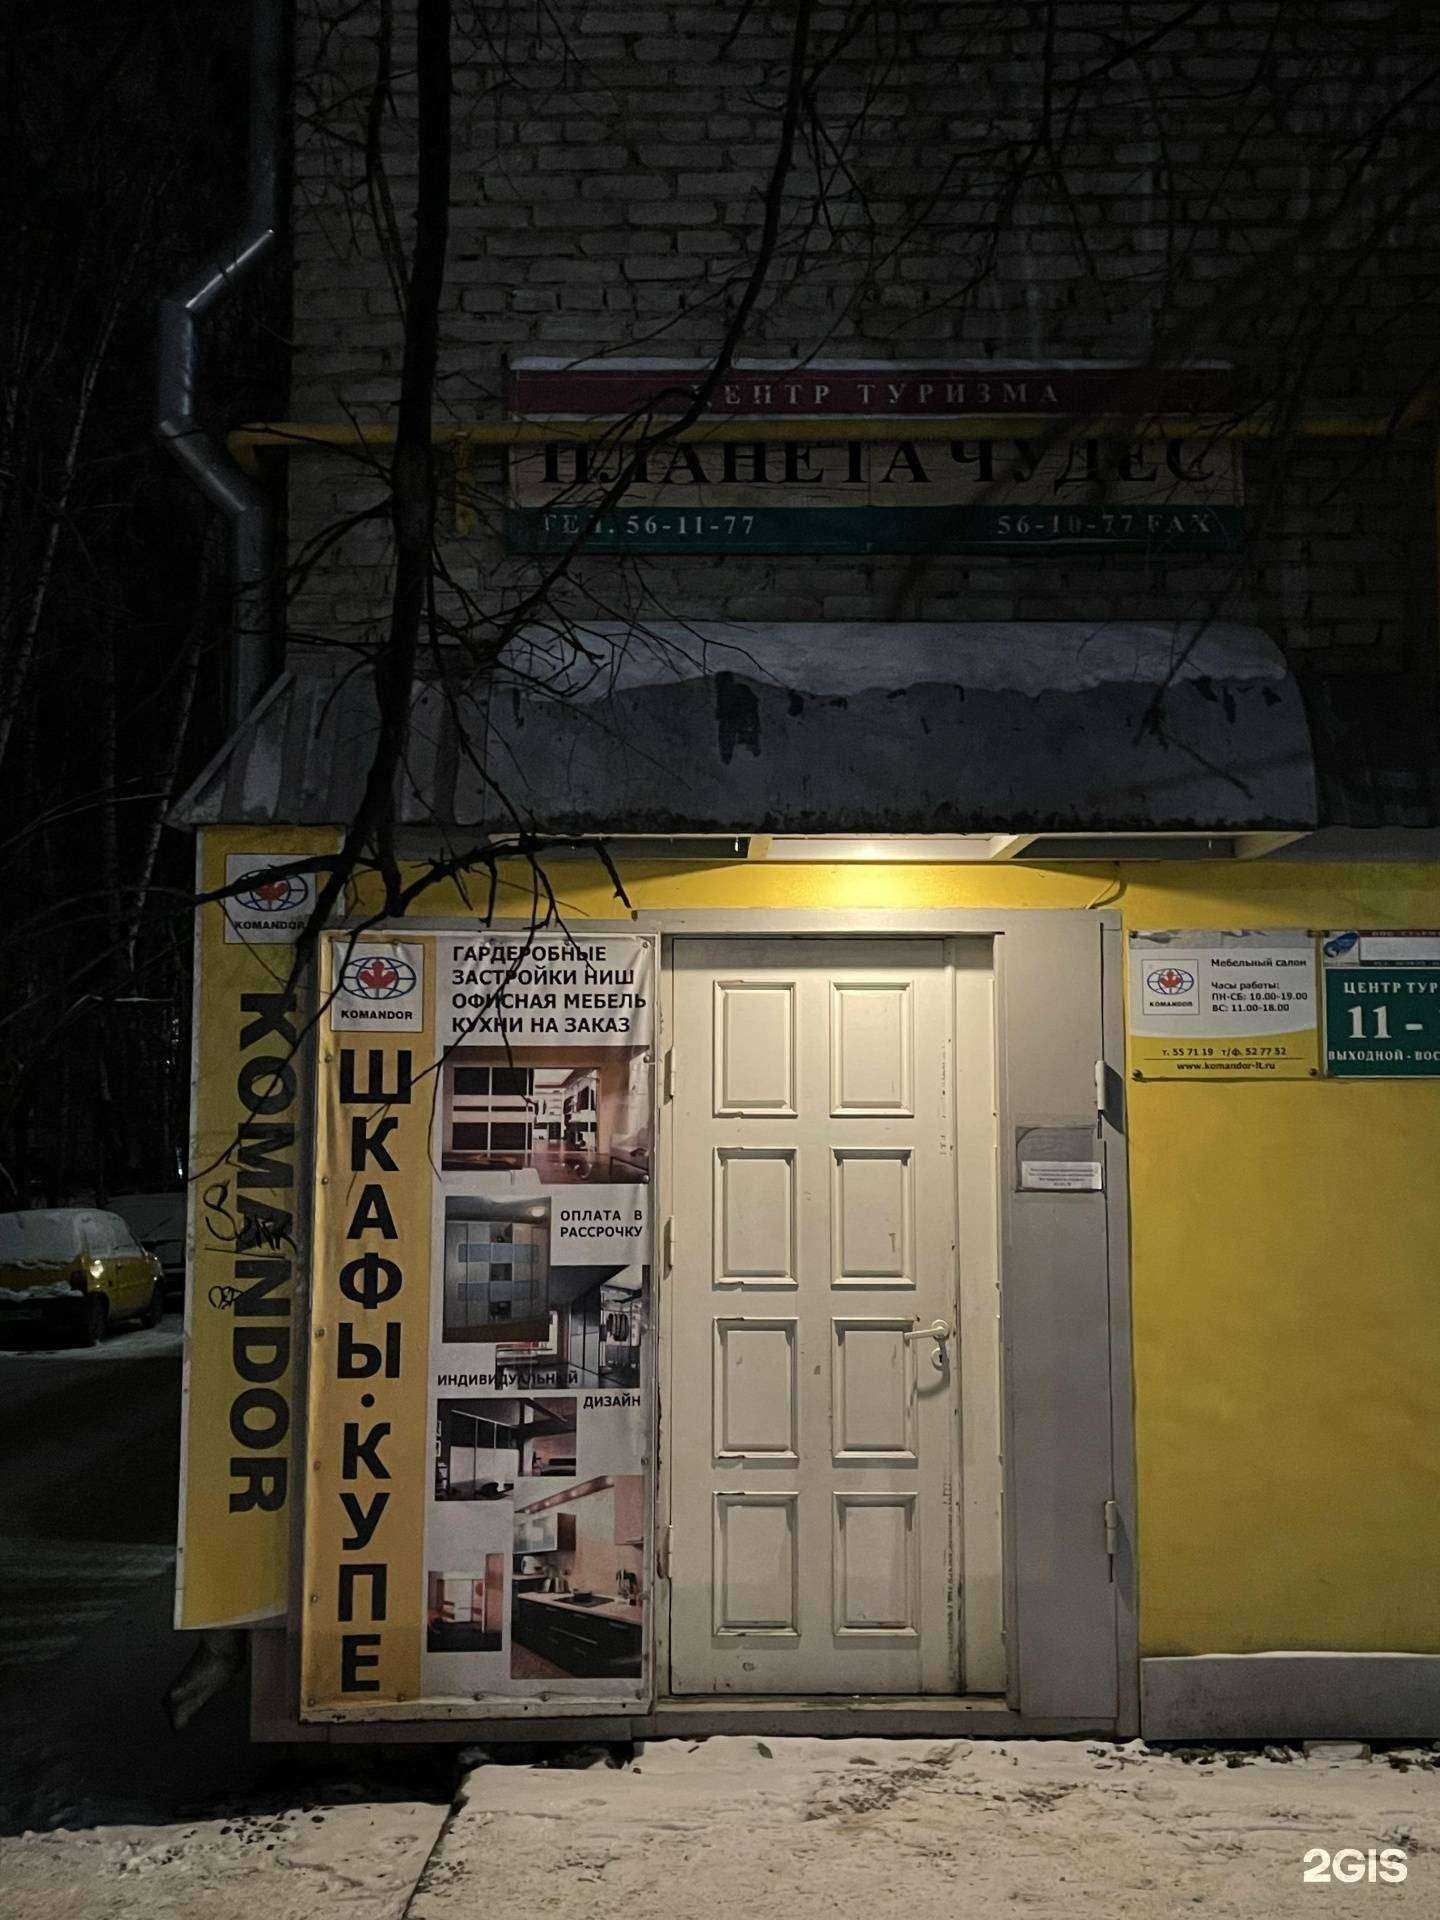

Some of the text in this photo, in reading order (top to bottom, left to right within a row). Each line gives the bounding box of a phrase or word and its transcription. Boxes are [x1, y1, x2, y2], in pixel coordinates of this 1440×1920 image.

[856, 382, 1059, 405] ТУРИЗМА
[625, 513, 755, 536] 56-11-77
[235, 919, 305, 931] KOMANDOR
[452, 945, 607, 964] ГАРДЕРОБНЫЕ
[1211, 957, 1307, 968] Мебельный салон
[452, 965, 634, 986] ЗАСТРОЙКИ НИШ
[1211, 980, 1280, 991] Часы работы:
[1343, 981, 1401, 995] ЦЕНТР
[452, 992, 647, 1010] ОФИСНАЯ МЕБЕЛЬ
[1211, 992, 1308, 1001] ПН-СБ: 10.00-19.00
[341, 1009, 413, 1021] KOMANDOR
[1346, 1005, 1392, 1039] 11
[452, 1016, 630, 1034] КУХНИ НА ЗАКАЗ
[1328, 1048, 1404, 1062] ВЫХОДНОЙ
[560, 1209, 643, 1221] ОПЛАТА В
[560, 1226, 643, 1238] РАССРОЧКУ
[228, 992, 297, 1515] KOMANDOR
[437, 1370, 578, 1388] ИНДИВИДУАЛЬНЫЙ
[582, 1392, 641, 1410] ДИЗАЙН
